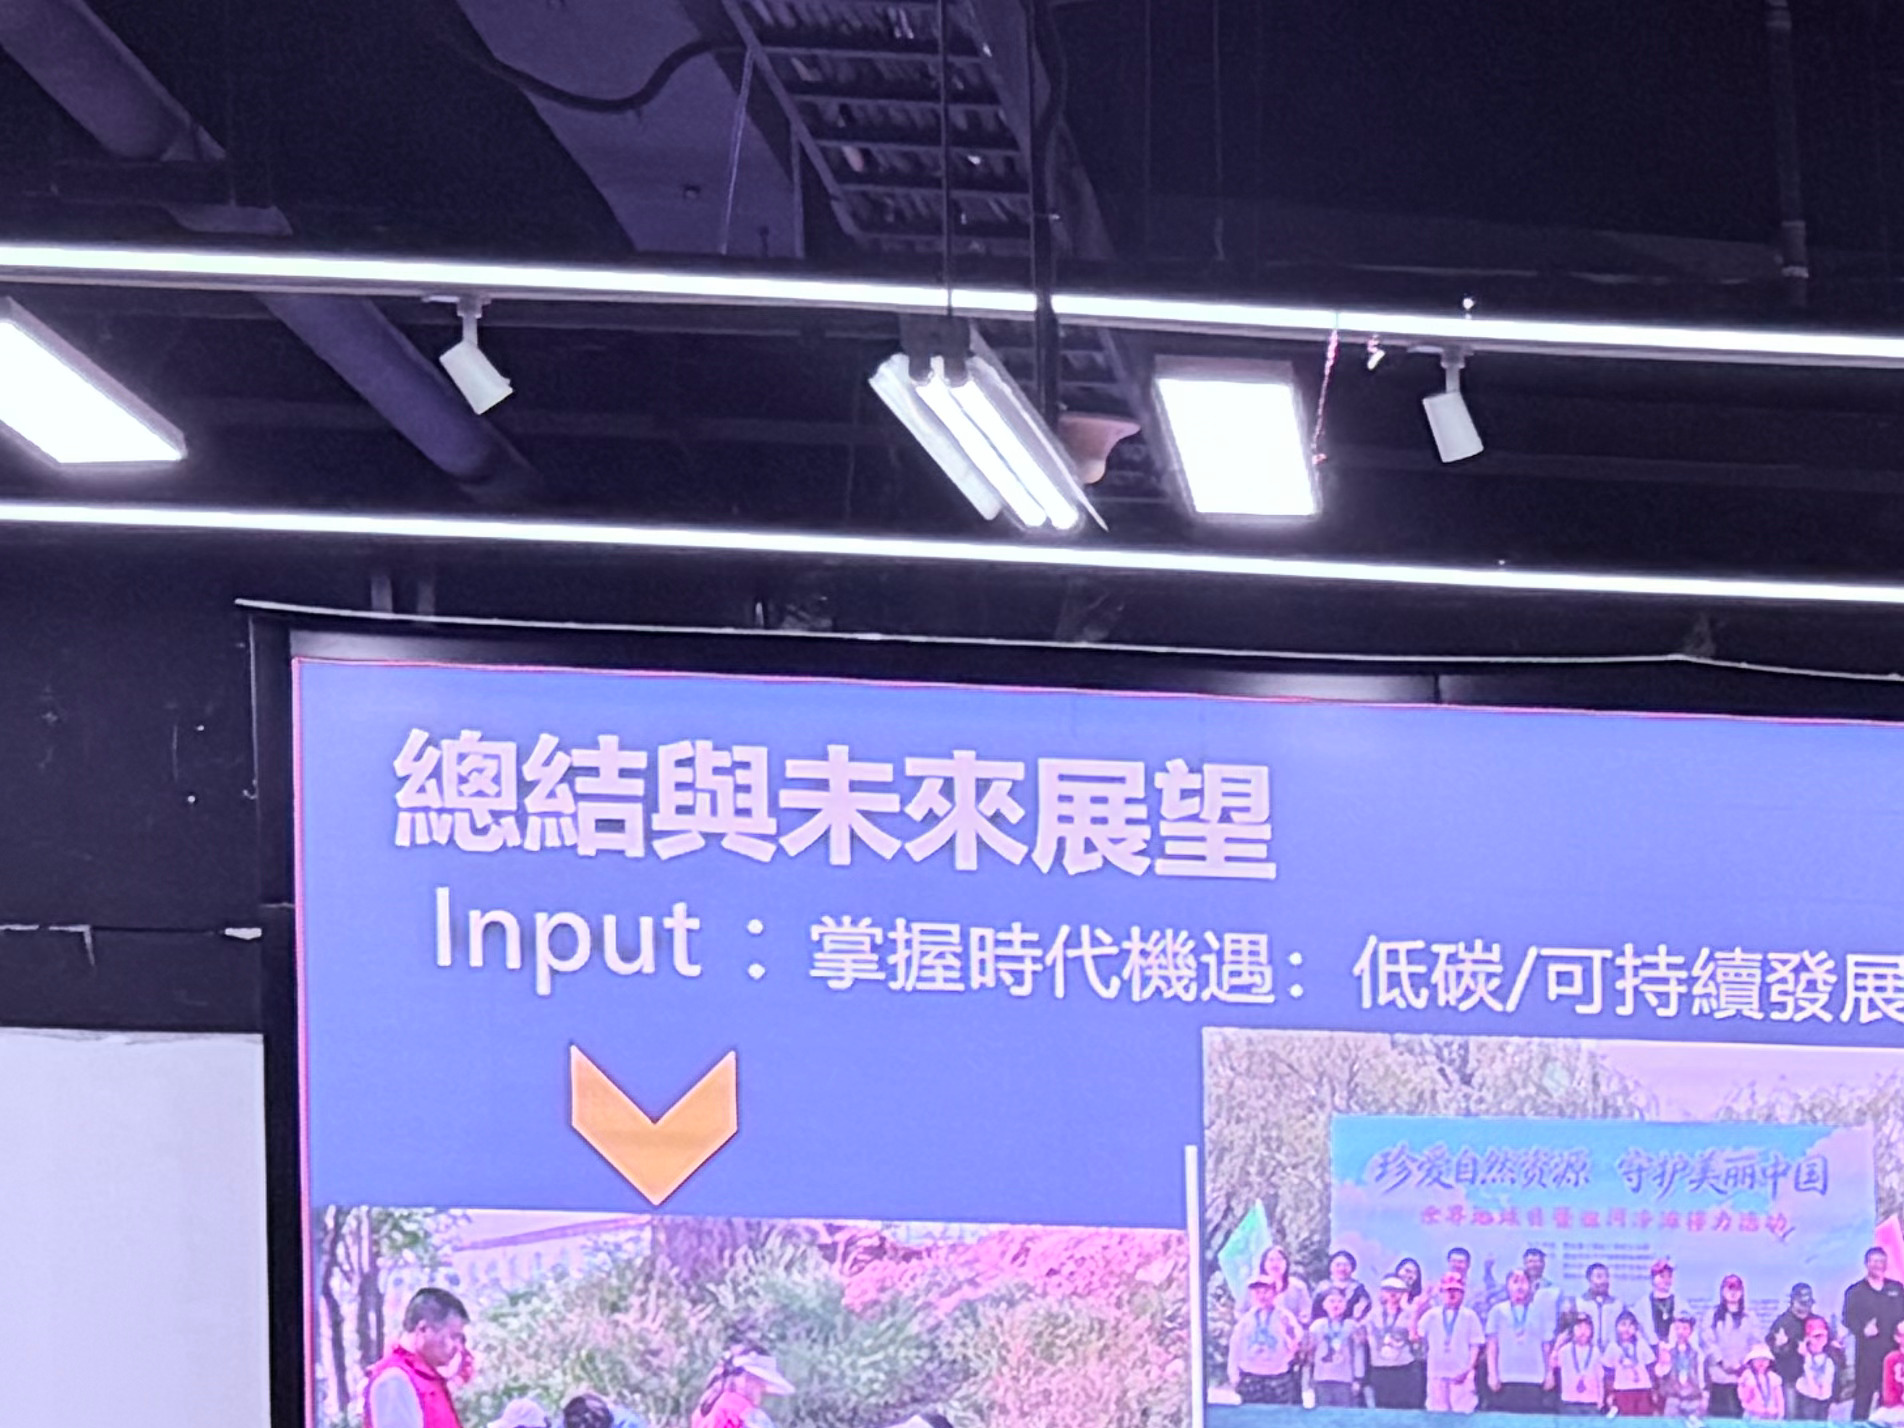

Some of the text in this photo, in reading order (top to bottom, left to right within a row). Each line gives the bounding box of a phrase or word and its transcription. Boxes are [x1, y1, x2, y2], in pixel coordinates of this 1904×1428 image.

[393, 727, 1278, 880] 總結與未來展望
